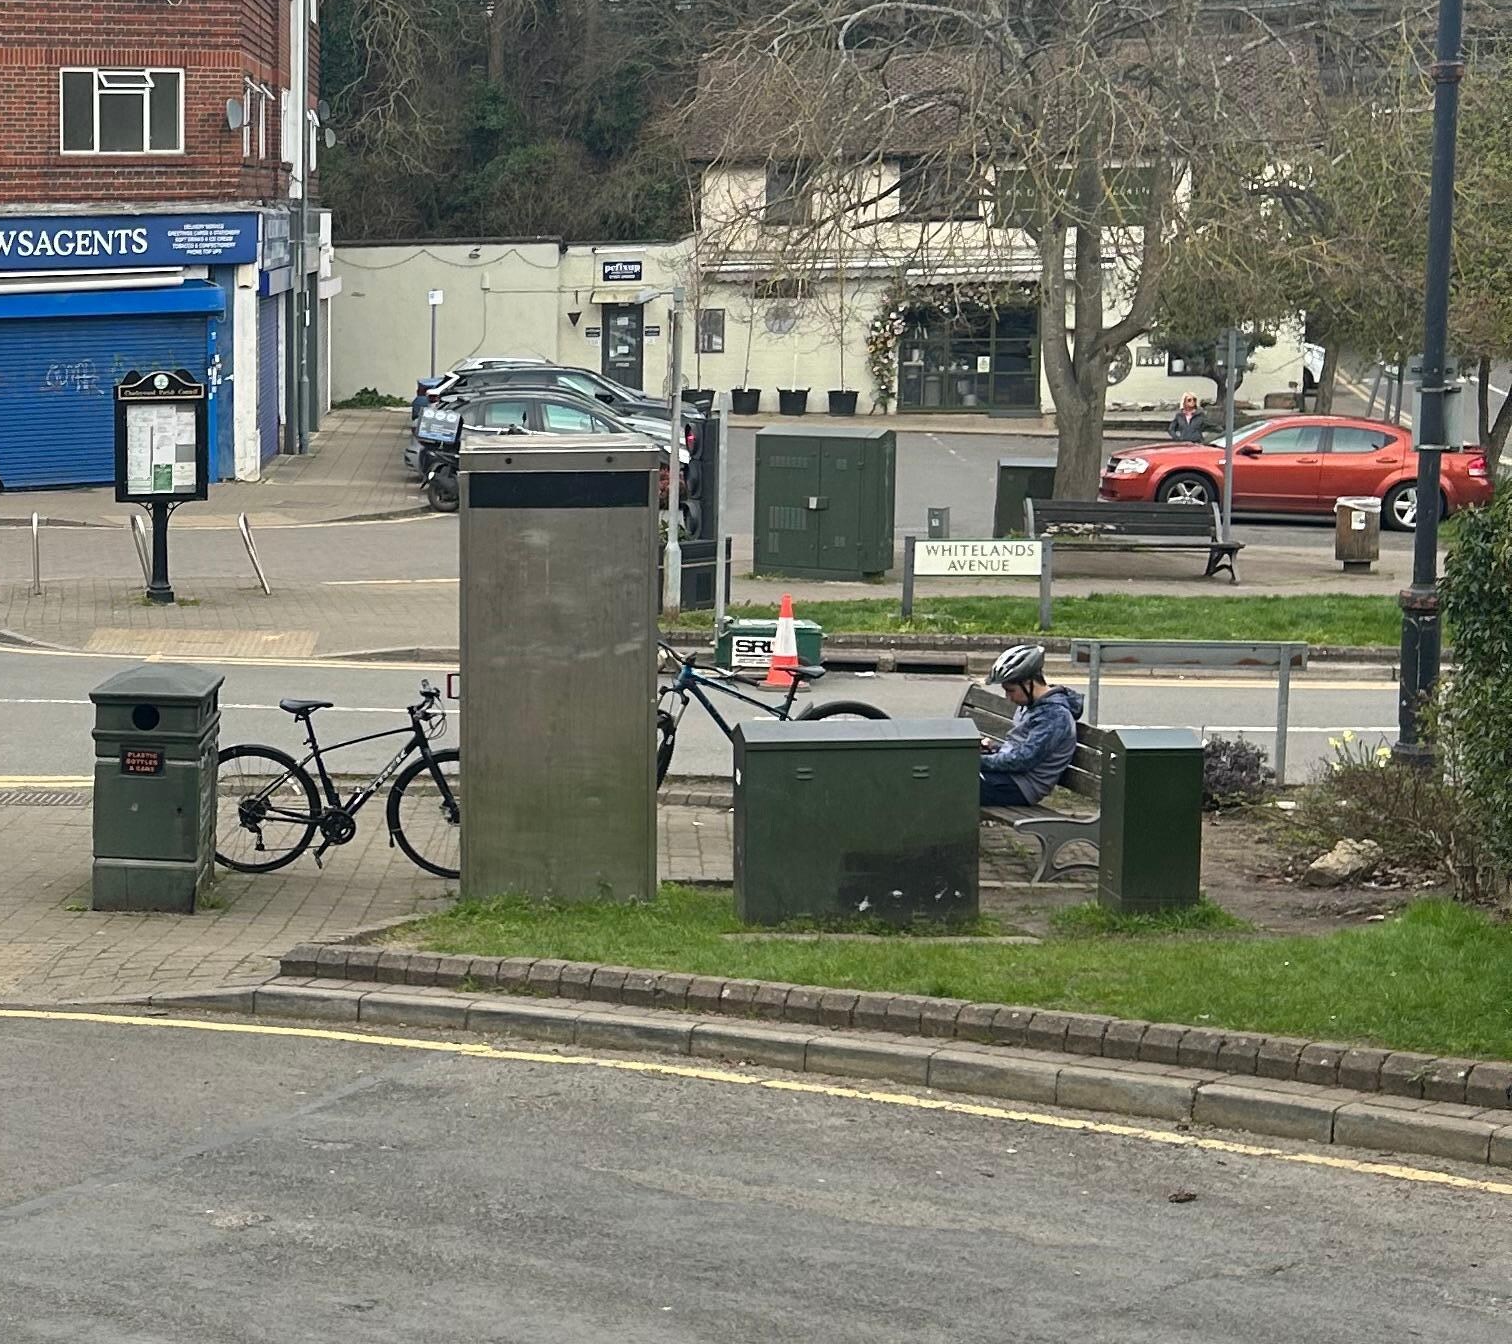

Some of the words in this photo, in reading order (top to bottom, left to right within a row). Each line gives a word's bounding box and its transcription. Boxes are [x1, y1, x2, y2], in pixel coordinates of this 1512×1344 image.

[926, 544, 1034, 556] WHITELANDS
[947, 559, 1010, 571] AVENUE
[126, 758, 158, 766] BOTTLES
